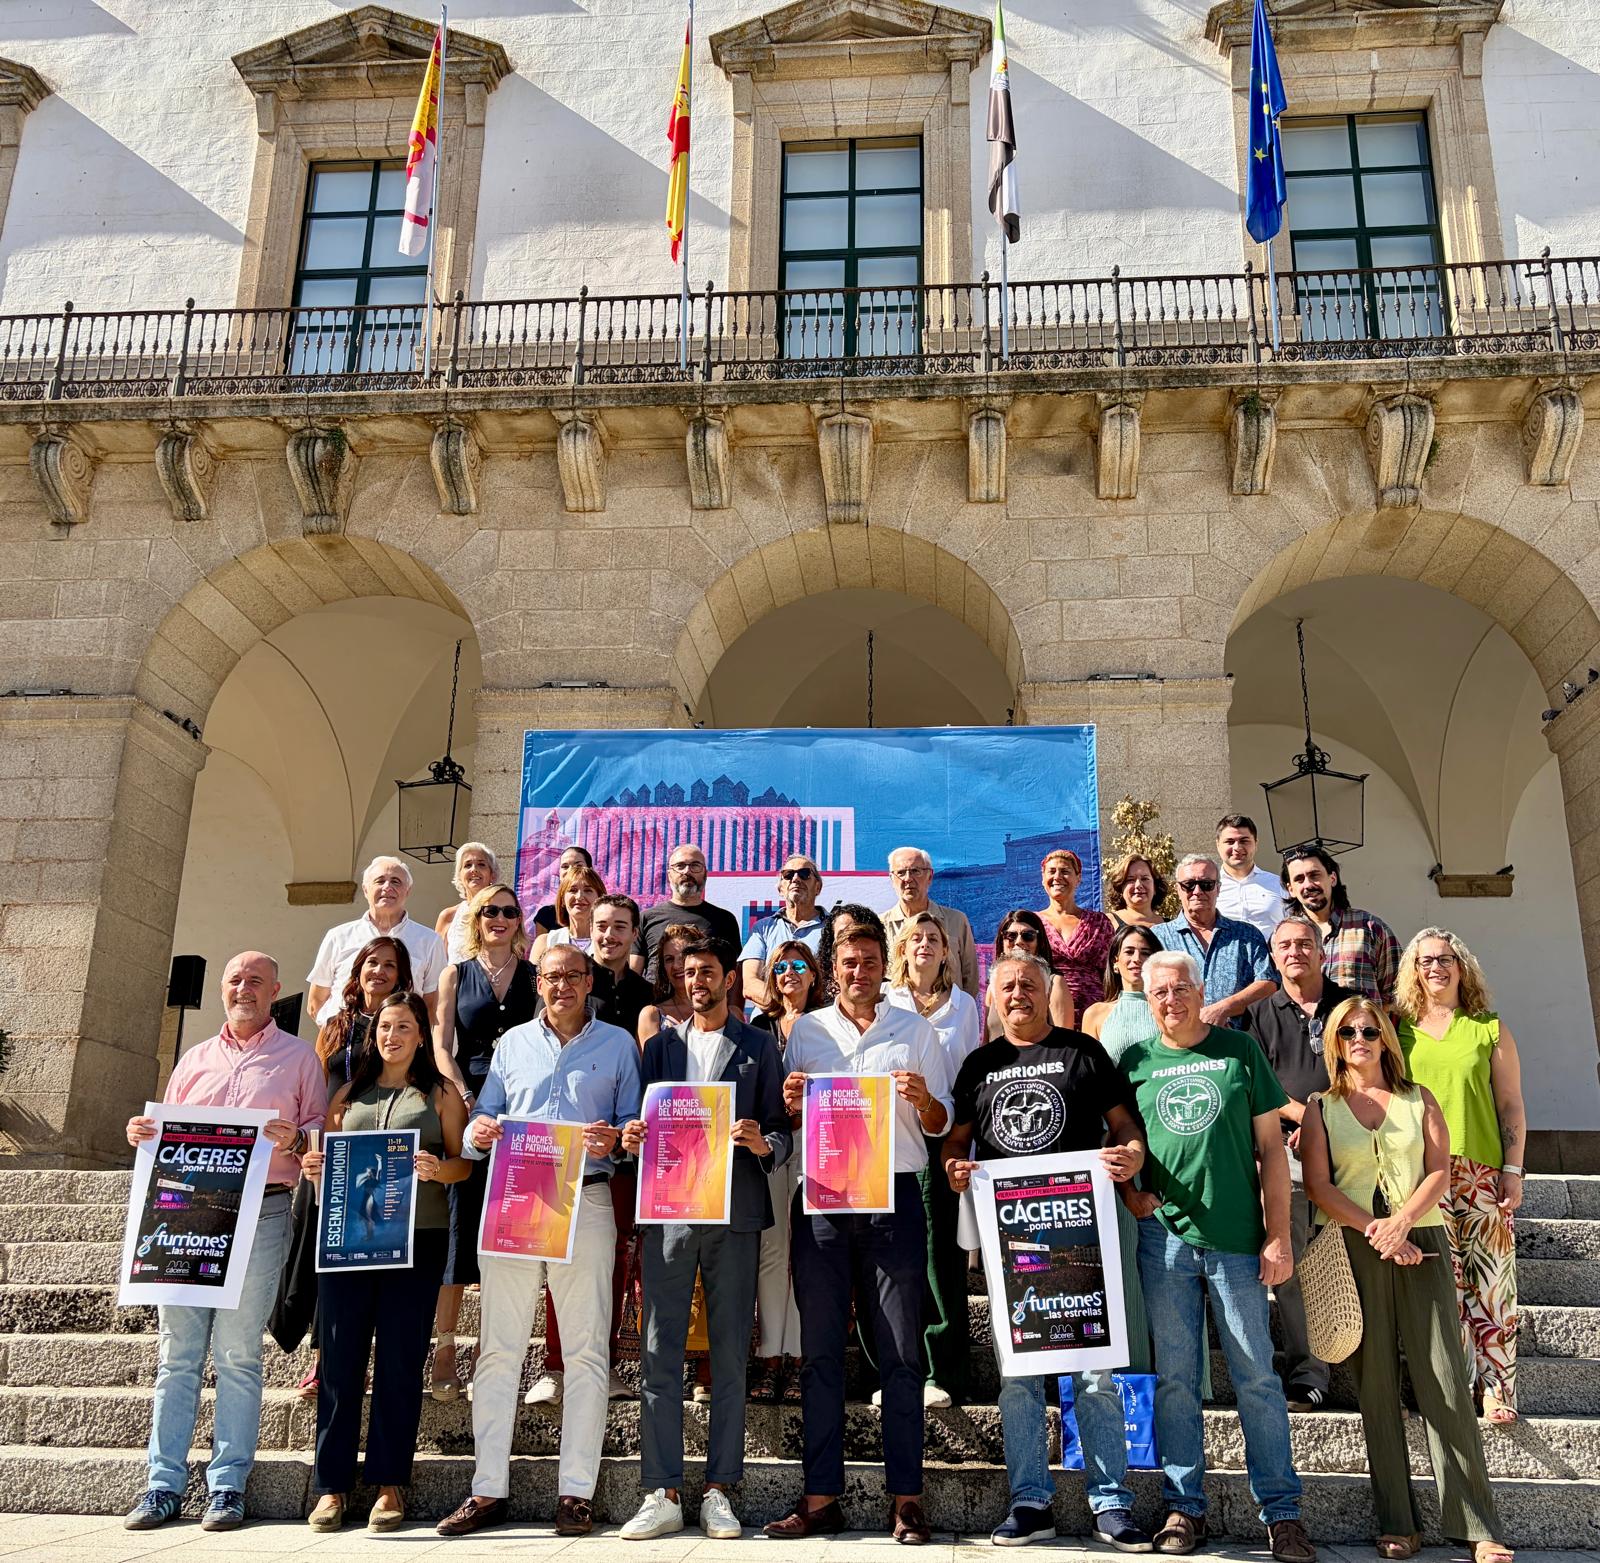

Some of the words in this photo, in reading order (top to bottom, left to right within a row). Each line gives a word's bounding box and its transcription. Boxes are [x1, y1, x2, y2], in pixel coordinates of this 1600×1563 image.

[986, 1061, 1064, 1084] FURRIONES
[1152, 1059, 1227, 1078] FURRIONES
[1171, 1078, 1206, 1087] BARITONOS
[819, 1089, 832, 1098] LAS
[833, 1089, 860, 1098] NOCHES
[1004, 1083, 1046, 1094] BARITONOS
[658, 1099, 672, 1108] LAS
[672, 1098, 699, 1108] NOCHES
[819, 1098, 831, 1107] DEL
[832, 1098, 872, 1107] PATRIMONIO
[658, 1107, 671, 1117] DEL
[672, 1107, 712, 1117] PATRIMONIO
[1032, 1093, 1062, 1147] CONTRATENORES
[511, 1132, 525, 1143] LAS
[526, 1134, 553, 1145] NOCHES
[1003, 1136, 1024, 1149] BAJOS
[159, 1142, 248, 1167] CÁCERES
[510, 1142, 524, 1152] DEL
[525, 1143, 566, 1156] PATRIMONIO
[206, 1164, 214, 1173] la
[216, 1165, 244, 1174] noche
[330, 1140, 347, 1205] PATRIMONIO
[999, 1198, 1092, 1225] CÁCERES
[327, 1205, 343, 1248] ESCENA
[1054, 1220, 1063, 1229] la
[1065, 1218, 1093, 1228] noche
[186, 1247, 225, 1258] estrellas
[1064, 1308, 1103, 1318] estrellas
[1050, 1331, 1075, 1340] cáceres
